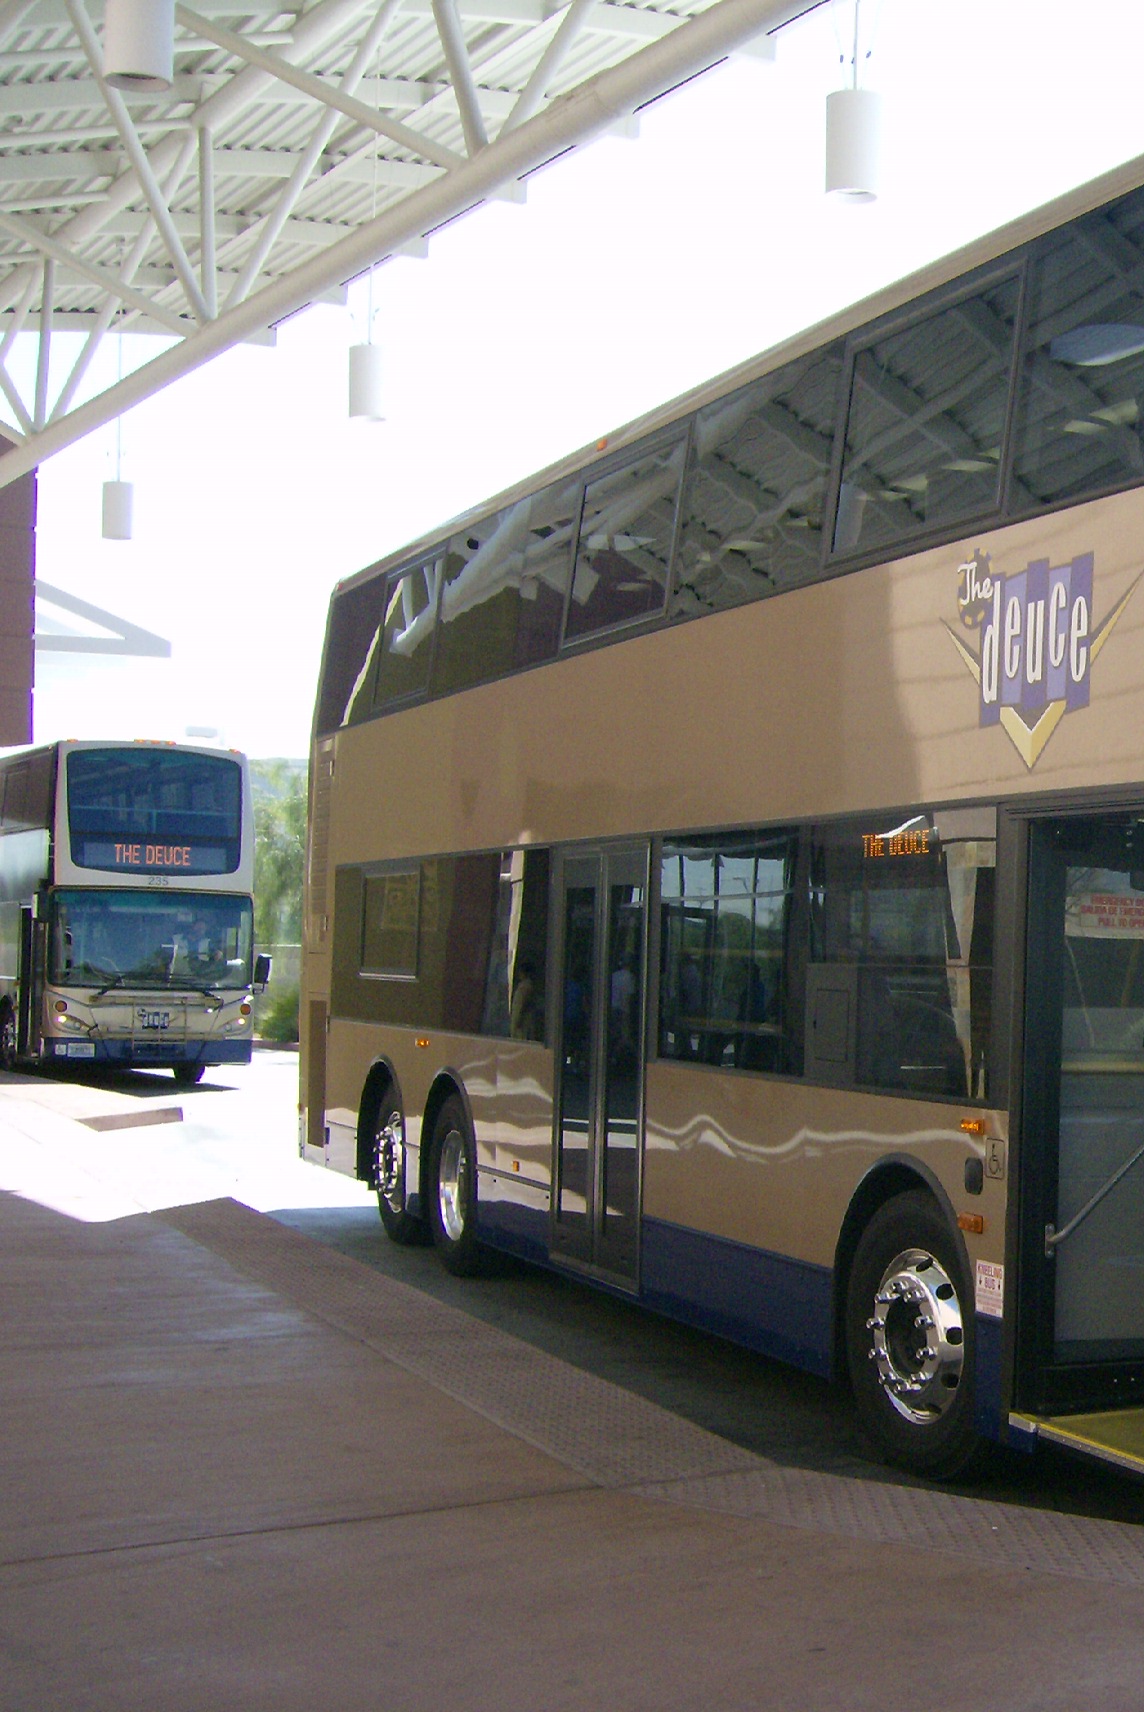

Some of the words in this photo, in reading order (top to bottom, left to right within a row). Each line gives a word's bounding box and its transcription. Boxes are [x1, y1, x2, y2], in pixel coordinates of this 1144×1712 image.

[957, 561, 994, 606] The
[982, 581, 1089, 704] deuce
[115, 844, 141, 864] THE
[145, 845, 191, 866] DEUCE
[862, 834, 885, 858] THE
[889, 829, 929, 856] DEUCE
